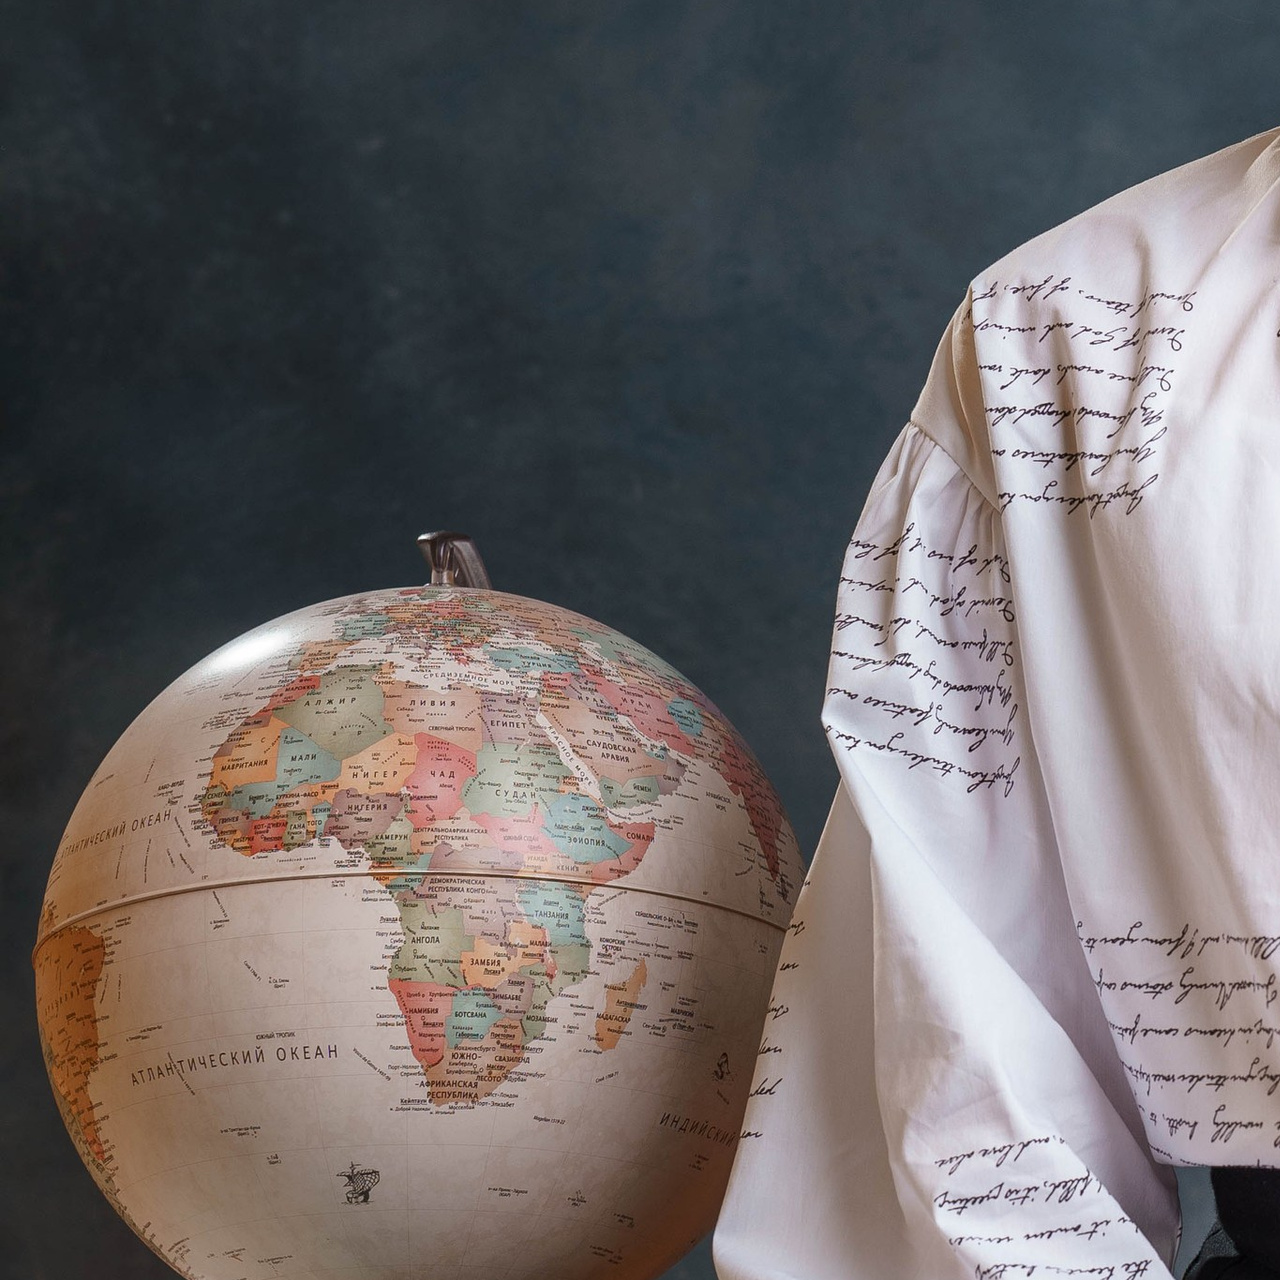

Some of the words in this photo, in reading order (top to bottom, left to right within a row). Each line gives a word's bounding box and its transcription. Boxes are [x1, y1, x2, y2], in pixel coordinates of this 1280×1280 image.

[304, 697, 357, 707] АЛЖИР
[490, 720, 526, 729] ЕГИПЕТ
[586, 739, 636, 754] САУДОВСКАЯ
[601, 752, 630, 763] АРАВИЯ
[221, 760, 268, 771] МАВРИТАНИЯ
[495, 789, 536, 799] СУДАН
[131, 809, 172, 832] ОКЕАН
[568, 837, 606, 847] ЭФИОПИЯ
[535, 910, 569, 920] ТАНЗАНИЯ
[470, 958, 500, 966] ЗАМБИЯ
[131, 1046, 266, 1087] АТЛАНТИЧЕСКИЙ
[276, 1044, 338, 1062] ОКЕАН
[426, 1092, 478, 1100] РЕСПУБЛИКА
[978, 1141, 1013, 1167] love
